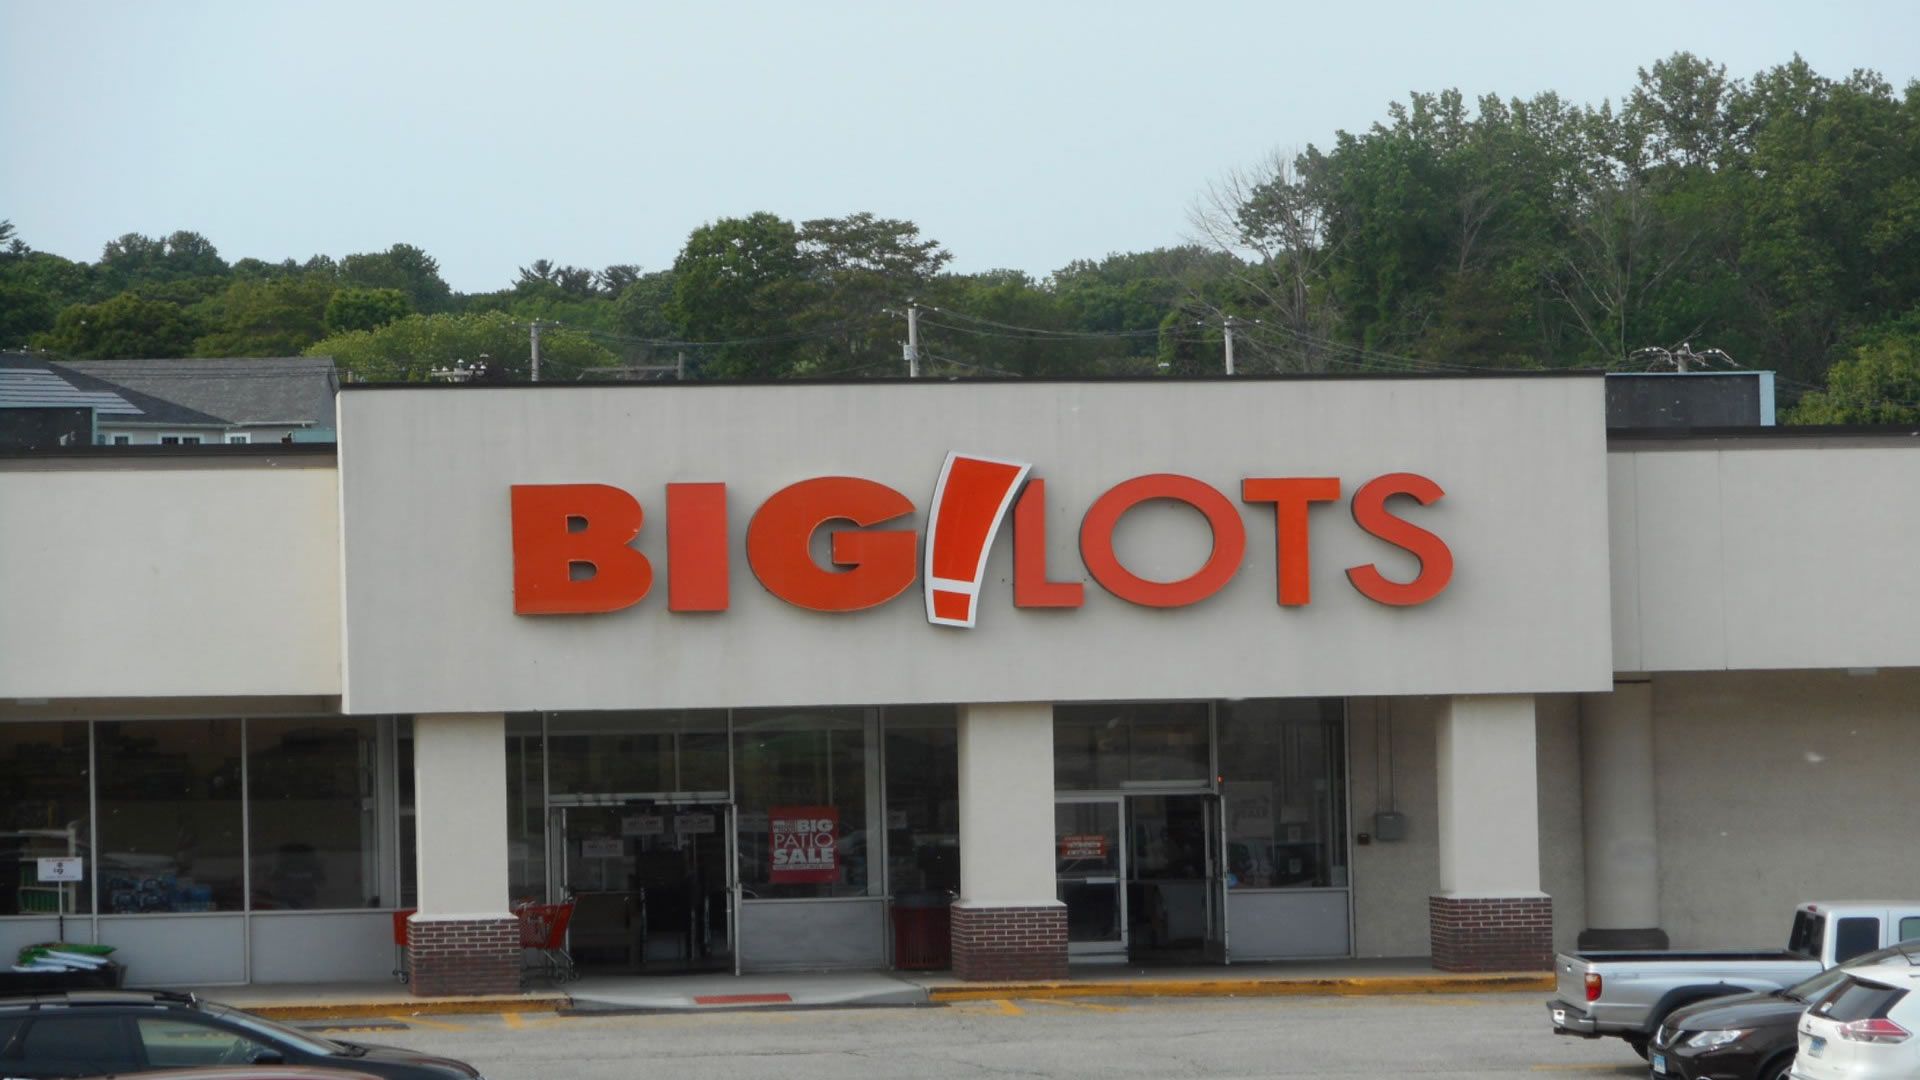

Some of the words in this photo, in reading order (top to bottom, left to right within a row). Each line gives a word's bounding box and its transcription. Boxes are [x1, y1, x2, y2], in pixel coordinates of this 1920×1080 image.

[1013, 472, 1453, 608] LOTS
[797, 818, 833, 833] BIG
[774, 832, 833, 849] PATIO
[773, 848, 834, 865] SALE
